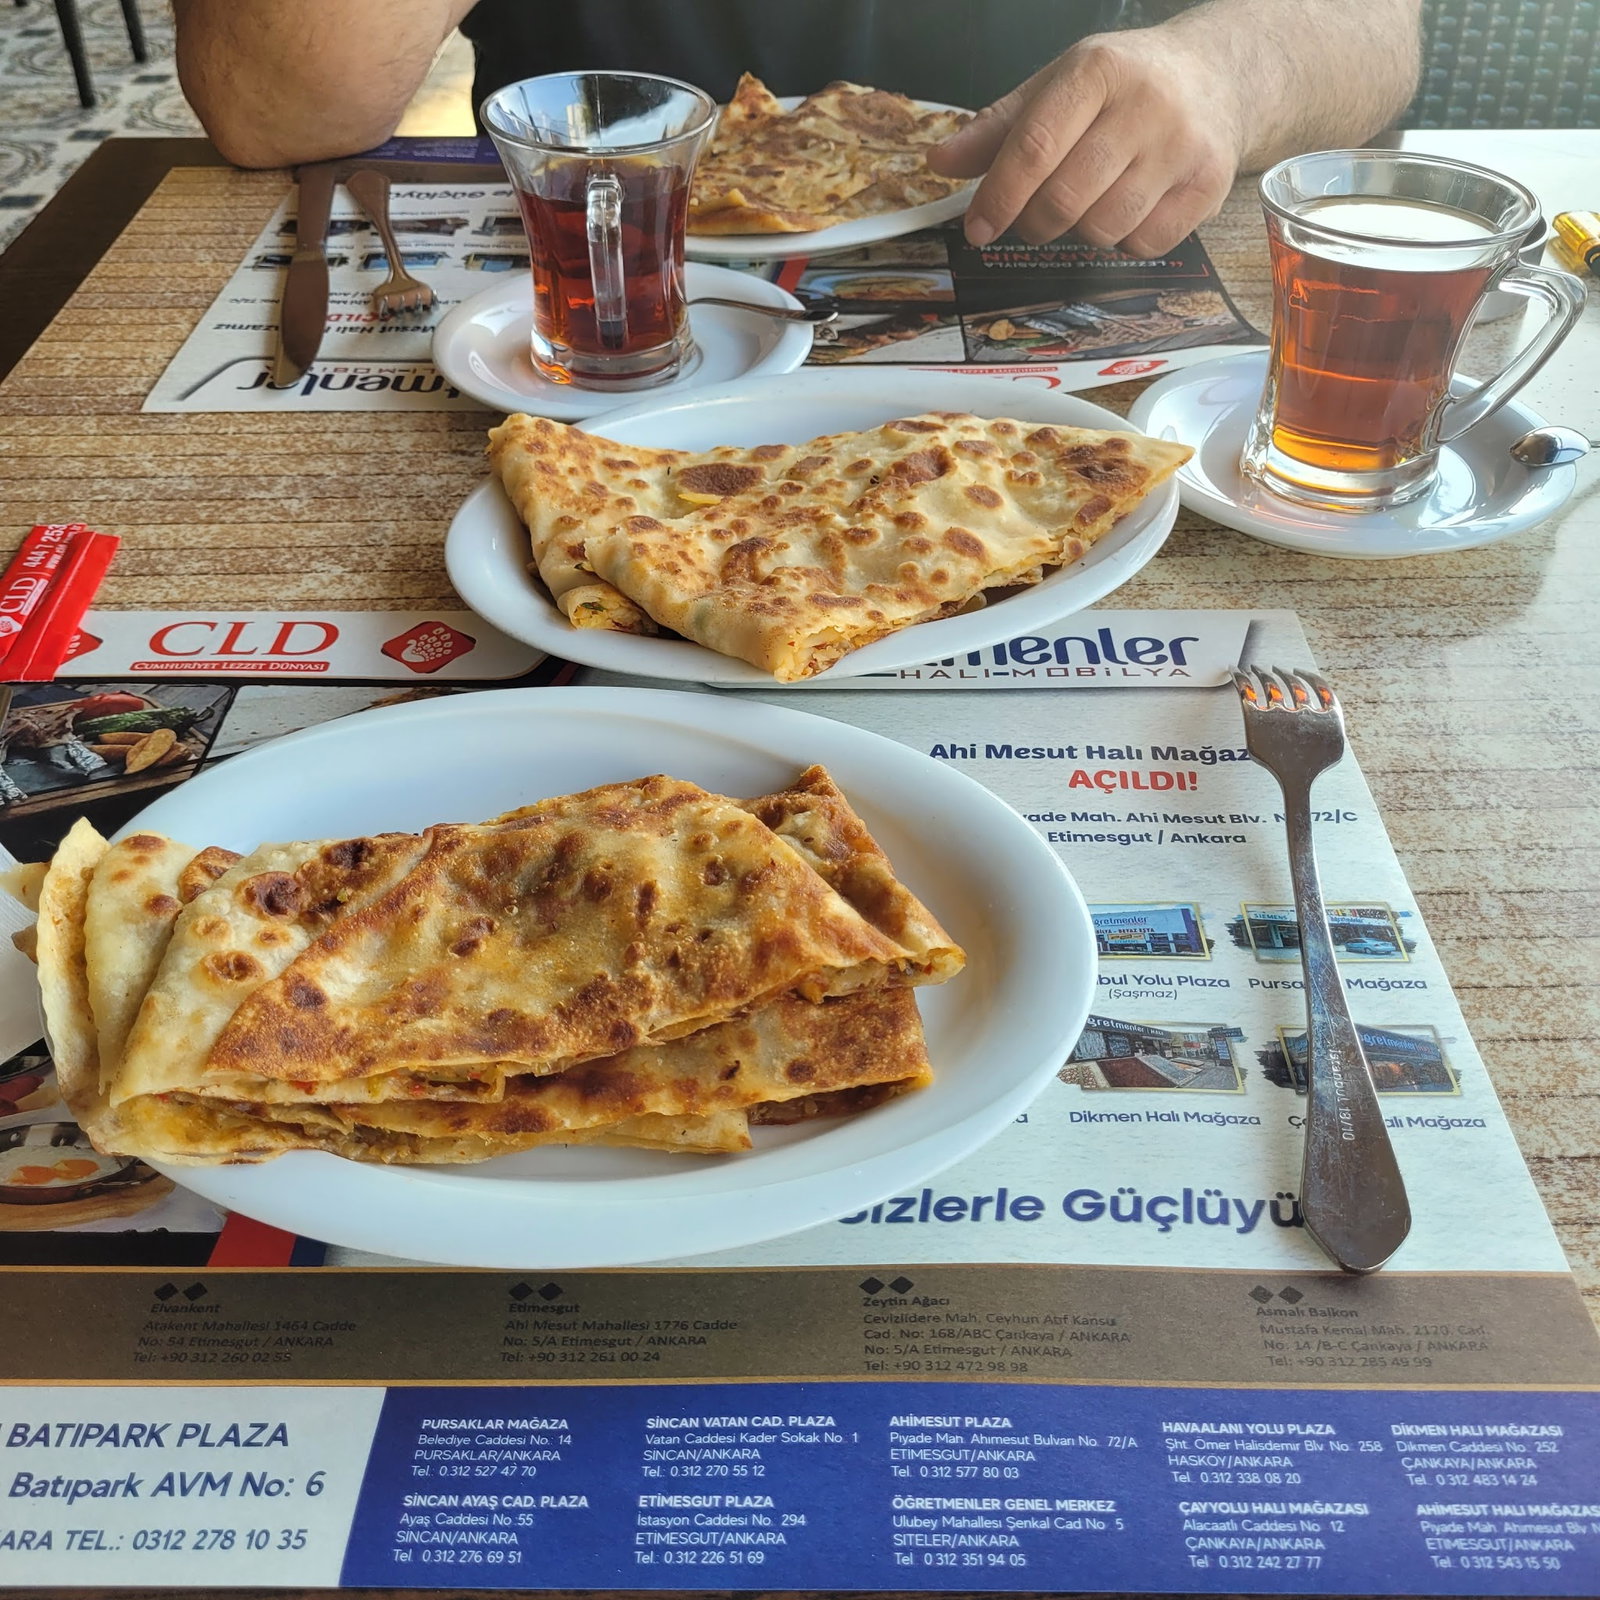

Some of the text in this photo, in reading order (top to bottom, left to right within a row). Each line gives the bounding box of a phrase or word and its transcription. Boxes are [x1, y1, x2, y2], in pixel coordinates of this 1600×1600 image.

[0, 577, 38, 613] CLD
[149, 621, 340, 656] CLD
[222, 662, 268, 670] LEZZET
[929, 744, 1251, 765] Ahi Mesut Halı Mağaz
[1069, 770, 1197, 794] AÇILDI!
[1071, 812, 1120, 822] Mah.
[1126, 812, 1158, 823] Ahi
[1163, 812, 1224, 824] Mesut
[1230, 813, 1266, 824] Blv.
[1048, 831, 1153, 844] Etimesgut
[1171, 832, 1246, 844] Ankara
[1132, 975, 1173, 986] Yolu
[1177, 976, 1230, 987] Plaza
[1250, 978, 1305, 989] Pursa
[1345, 978, 1427, 991] Mağaza
[1108, 988, 1177, 999] (Şaşmaz)
[1070, 1111, 1261, 1126] Dikmen Halı Mağaza
[1408, 1116, 1486, 1130] Mağaza
[1063, 1187, 1304, 1234] Güçlüyü
[150, 1303, 221, 1313] Elvankent
[863, 1297, 949, 1308] Zeytin Ağacı
[508, 1304, 580, 1315] Etimesgut
[1309, 1308, 1358, 1317] Balkon
[313, 1321, 356, 1331] Cadde
[534, 1321, 737, 1331] Mesut Mahallesi 1776 Cadde
[273, 1337, 334, 1347] ANKARA
[561, 1336, 707, 1348] Etimesgut ANKARA
[559, 1352, 659, 1362] 312 00 24
[926, 1361, 951, 1371] 312
[422, 1417, 568, 1429] PURSAKLAR MAĞAZA
[647, 1416, 835, 1428] SİNCAN VATAN CAD. PLAZA
[889, 1414, 1012, 1428] AHİMESUT PLAZA
[1162, 1422, 1335, 1435] HAVAALANI YOLU PLAZA
[1391, 1423, 1563, 1436] DİKMEN HALI MAĞAZASI
[6, 1423, 171, 1447] BATIPARK
[176, 1423, 289, 1447] PLAZA
[418, 1434, 572, 1447] Belediye Caddesi 14
[646, 1432, 858, 1444] Vatan Caddesi Kader Sokak 1
[1107, 1436, 1137, 1449] 72/A
[1359, 1441, 1383, 1451] 258
[1536, 1442, 1559, 1452] 252
[415, 1450, 561, 1462] PURSAKLAR/ANKARA
[643, 1448, 760, 1461] SİNCAN/ANKARA
[1401, 1458, 1537, 1471] ÇANKAYA/ANKARA
[474, 1466, 536, 1477] 527 47 70
[706, 1466, 765, 1476] 270 55 12
[956, 1467, 1019, 1478] 577 80 03
[1238, 1473, 1301, 1484] 338 08 20
[8, 1470, 326, 1504] Batıpark AVM No: 6
[403, 1493, 589, 1510] SİNCAN AYAŞ CAD. PLAZA
[639, 1493, 774, 1507] ETİMESGUT PLAZA
[893, 1495, 1116, 1511] ÖĞRETMENLER GENEL MERKEZ
[1179, 1501, 1369, 1515] ÇAYYOLU HALI MAĞAZASI
[1417, 1502, 1524, 1516] AHİMESUT HALI
[400, 1513, 488, 1527] Ayaş Caddesi
[637, 1511, 806, 1528] İstasyon Caddesi 294
[893, 1516, 1123, 1531] Ulubey Şenkal 5
[1183, 1520, 1345, 1532] Alacaatlı 12
[0, 1529, 52, 1550] ARA
[133, 1529, 183, 1550] 0312
[192, 1530, 235, 1550] 278
[245, 1529, 270, 1550] 10
[276, 1528, 307, 1550] 35
[396, 1529, 518, 1545] SİNCAN/ANKARA
[636, 1531, 786, 1546] ETİMESGUT/ANKARA
[1185, 1537, 1325, 1551] ÇANKAYA/ANKARA
[460, 1551, 521, 1563] 276 69 51
[702, 1552, 764, 1564] 226 51 69
[963, 1554, 1026, 1565] 351 94 05
[1258, 1557, 1321, 1569] 242 27 77
